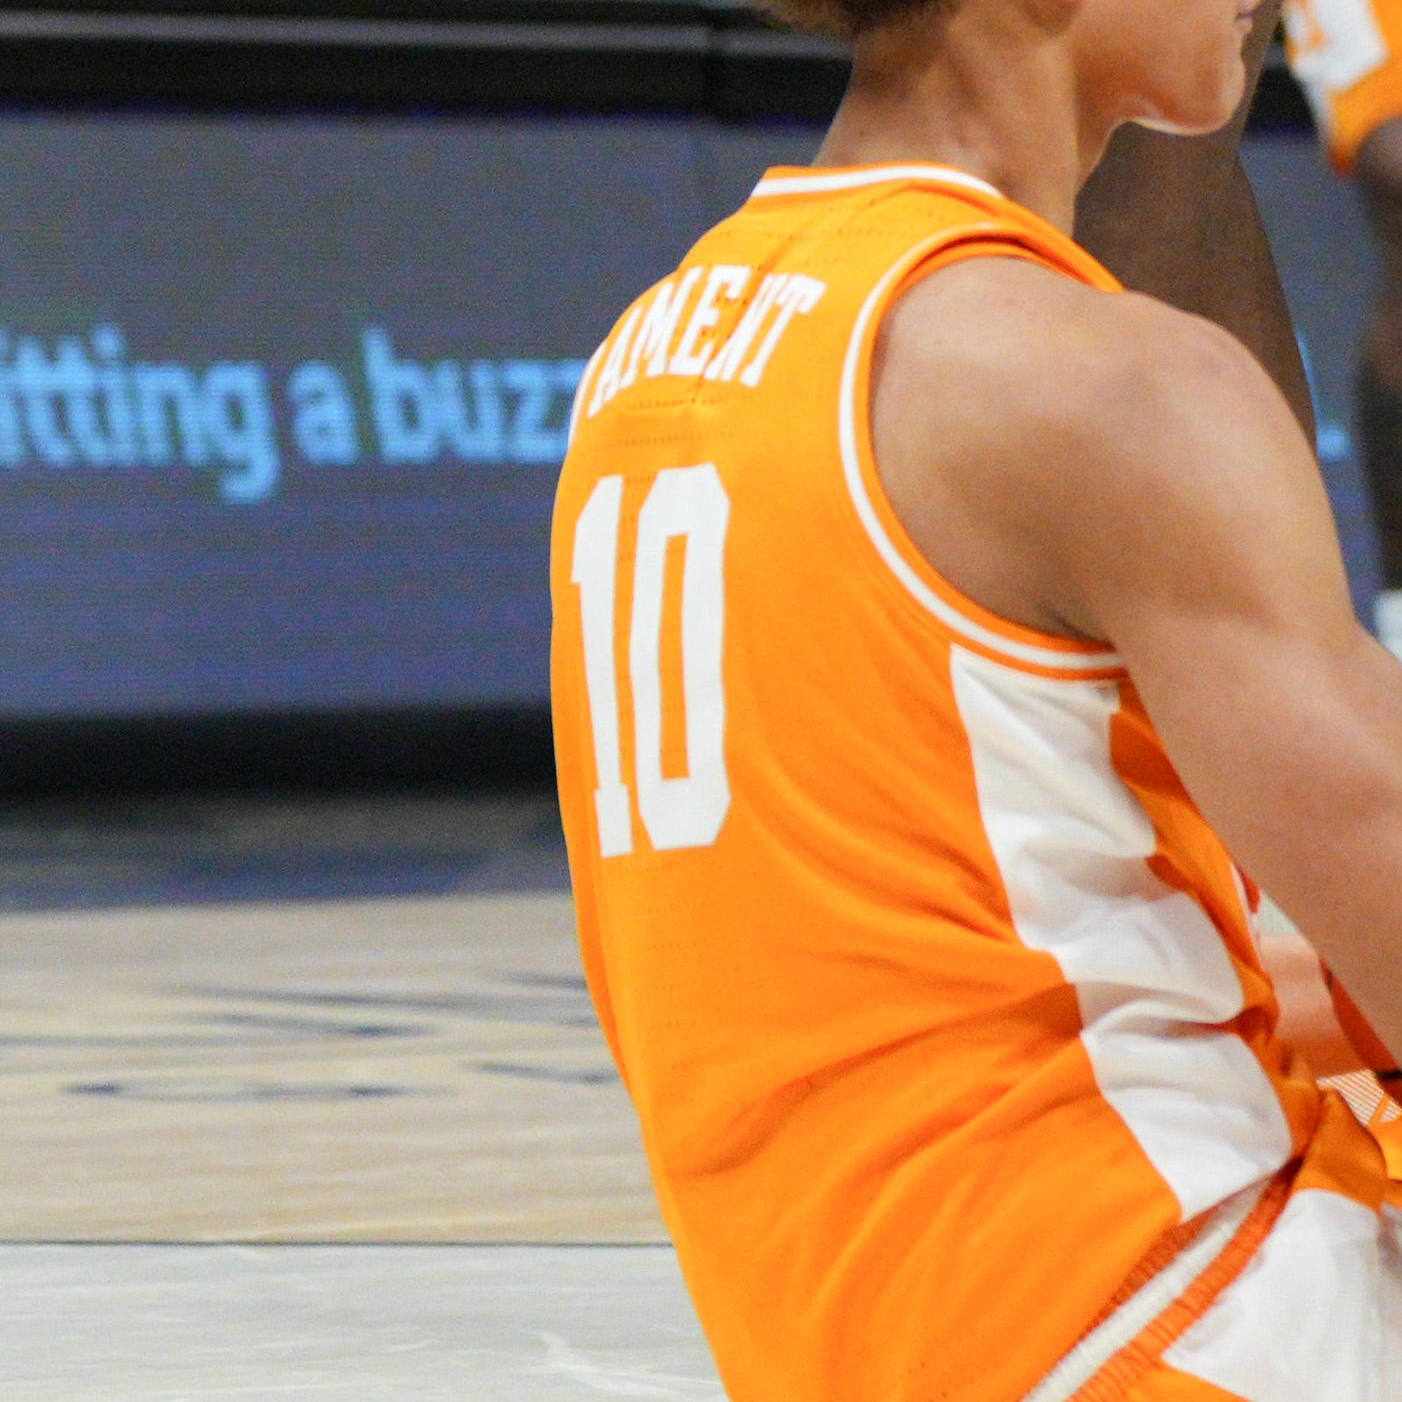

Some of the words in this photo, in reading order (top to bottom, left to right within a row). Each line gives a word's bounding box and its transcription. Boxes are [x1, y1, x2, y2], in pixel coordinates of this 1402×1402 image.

[289, 360, 360, 467] a
[587, 265, 828, 418] AMENT
[571, 462, 731, 858] 10
